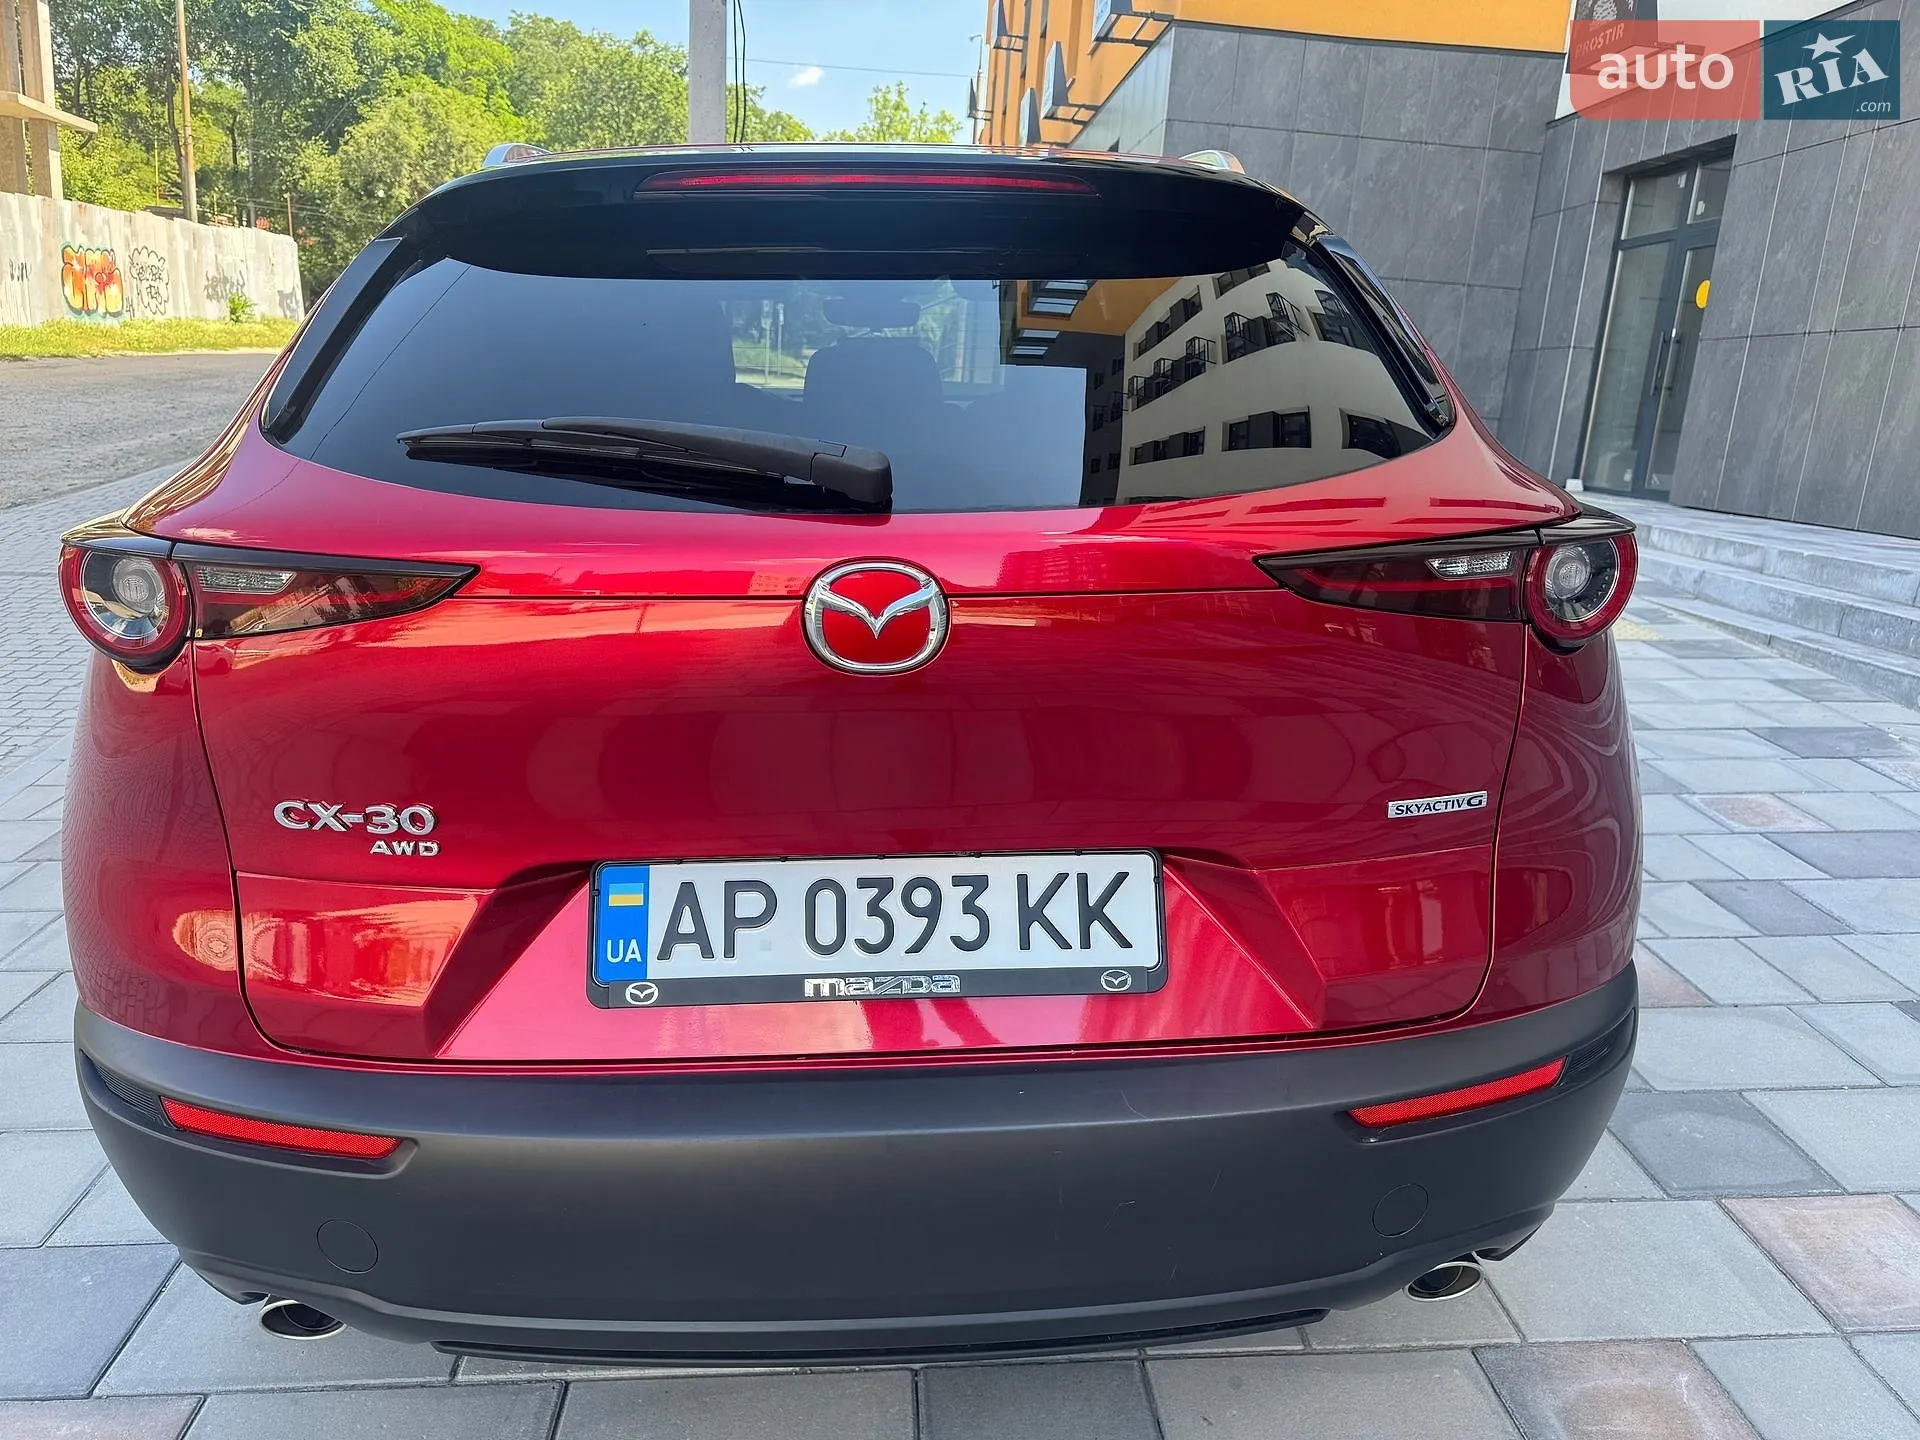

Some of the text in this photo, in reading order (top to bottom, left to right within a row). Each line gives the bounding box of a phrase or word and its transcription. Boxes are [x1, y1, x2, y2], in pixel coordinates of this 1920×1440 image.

[273, 799, 438, 836] CX-30
[369, 839, 441, 857] AWD
[655, 870, 1134, 962] AP 0393 KK
[606, 938, 642, 964] UA
